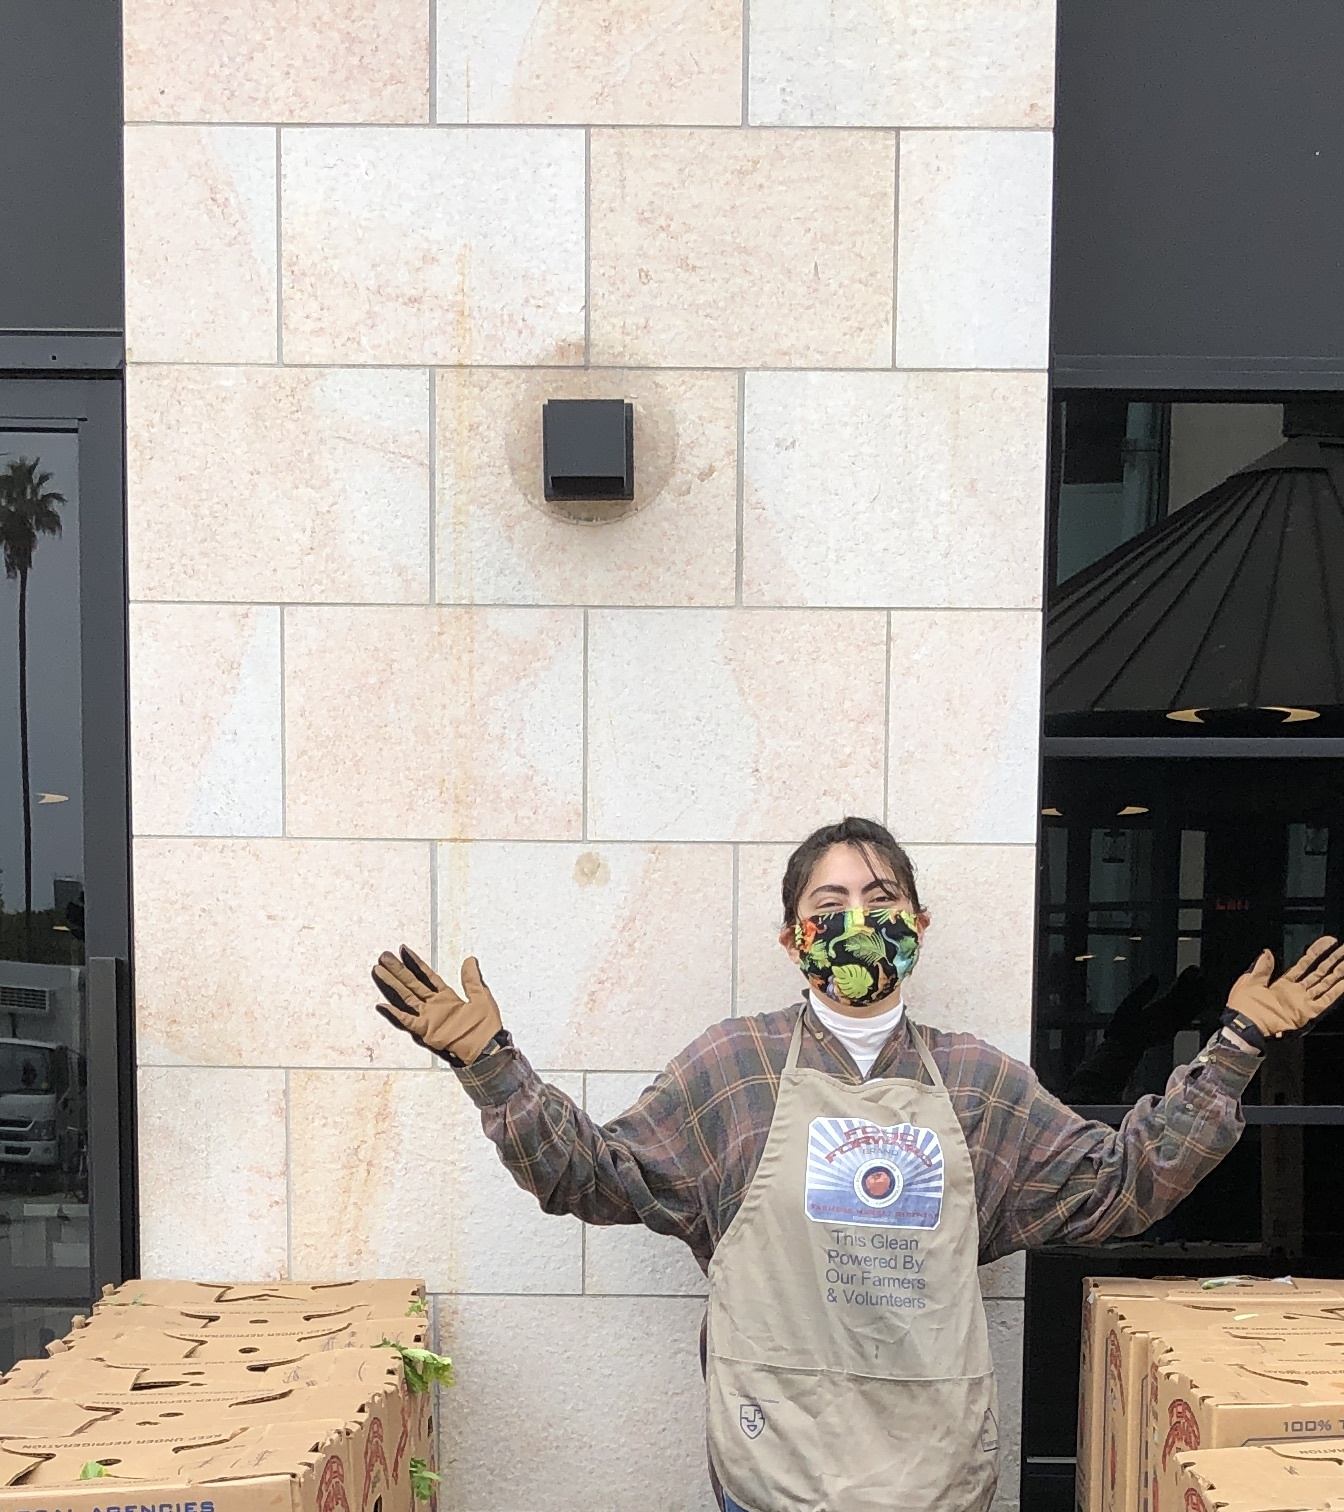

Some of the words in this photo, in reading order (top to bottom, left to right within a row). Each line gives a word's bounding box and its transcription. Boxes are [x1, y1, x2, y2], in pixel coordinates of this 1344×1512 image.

[832, 1230, 866, 1248] This
[870, 1234, 919, 1252] Glean
[826, 1250, 897, 1270] Powered
[902, 1254, 924, 1272] By
[826, 1269, 856, 1286] Our
[861, 1272, 926, 1290] Farmers
[826, 1288, 838, 1304] &
[843, 1289, 926, 1309] Volunteers
[1283, 1420, 1332, 1432] 100%
